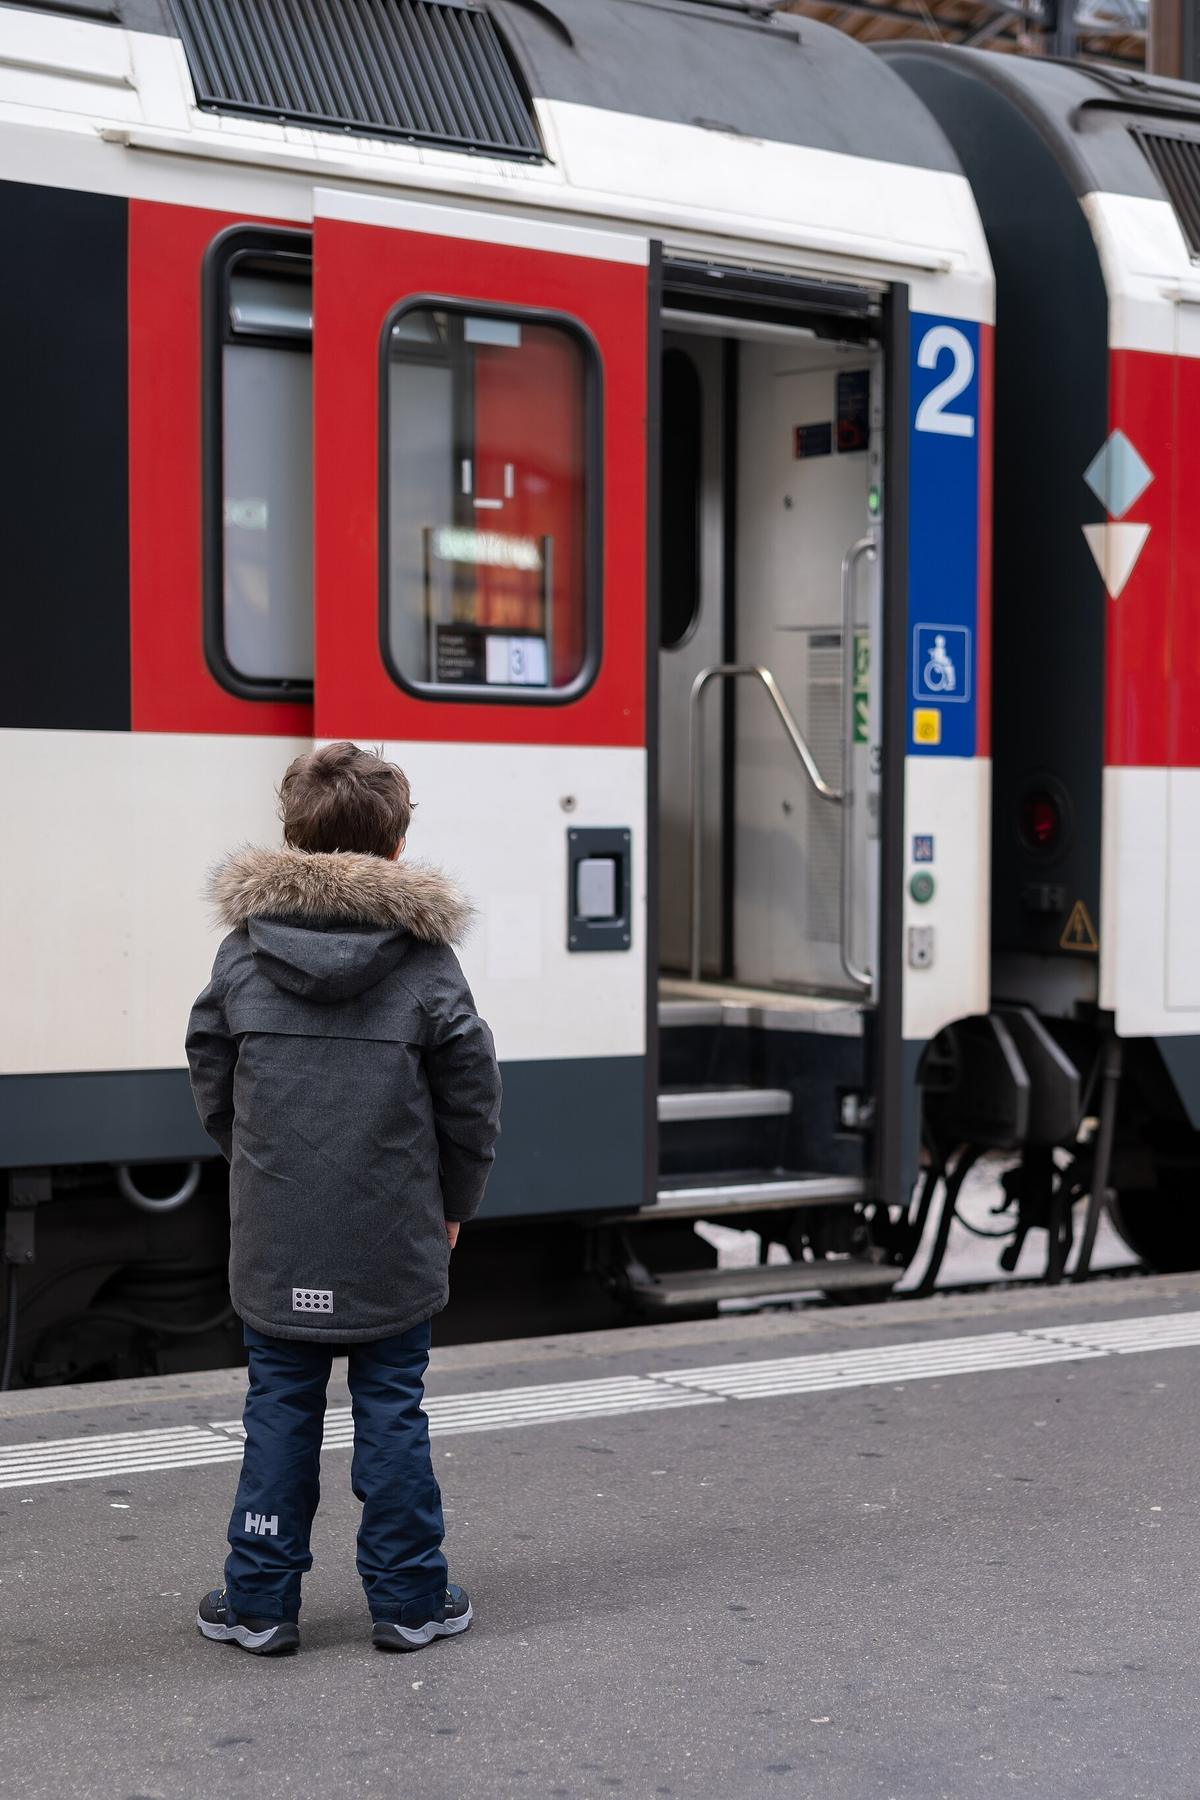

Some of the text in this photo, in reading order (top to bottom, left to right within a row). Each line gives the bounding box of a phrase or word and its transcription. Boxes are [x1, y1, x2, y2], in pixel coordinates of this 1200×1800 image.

[914, 324, 975, 438] 2
[511, 649, 525, 675] 3
[244, 1511, 279, 1536] HH
